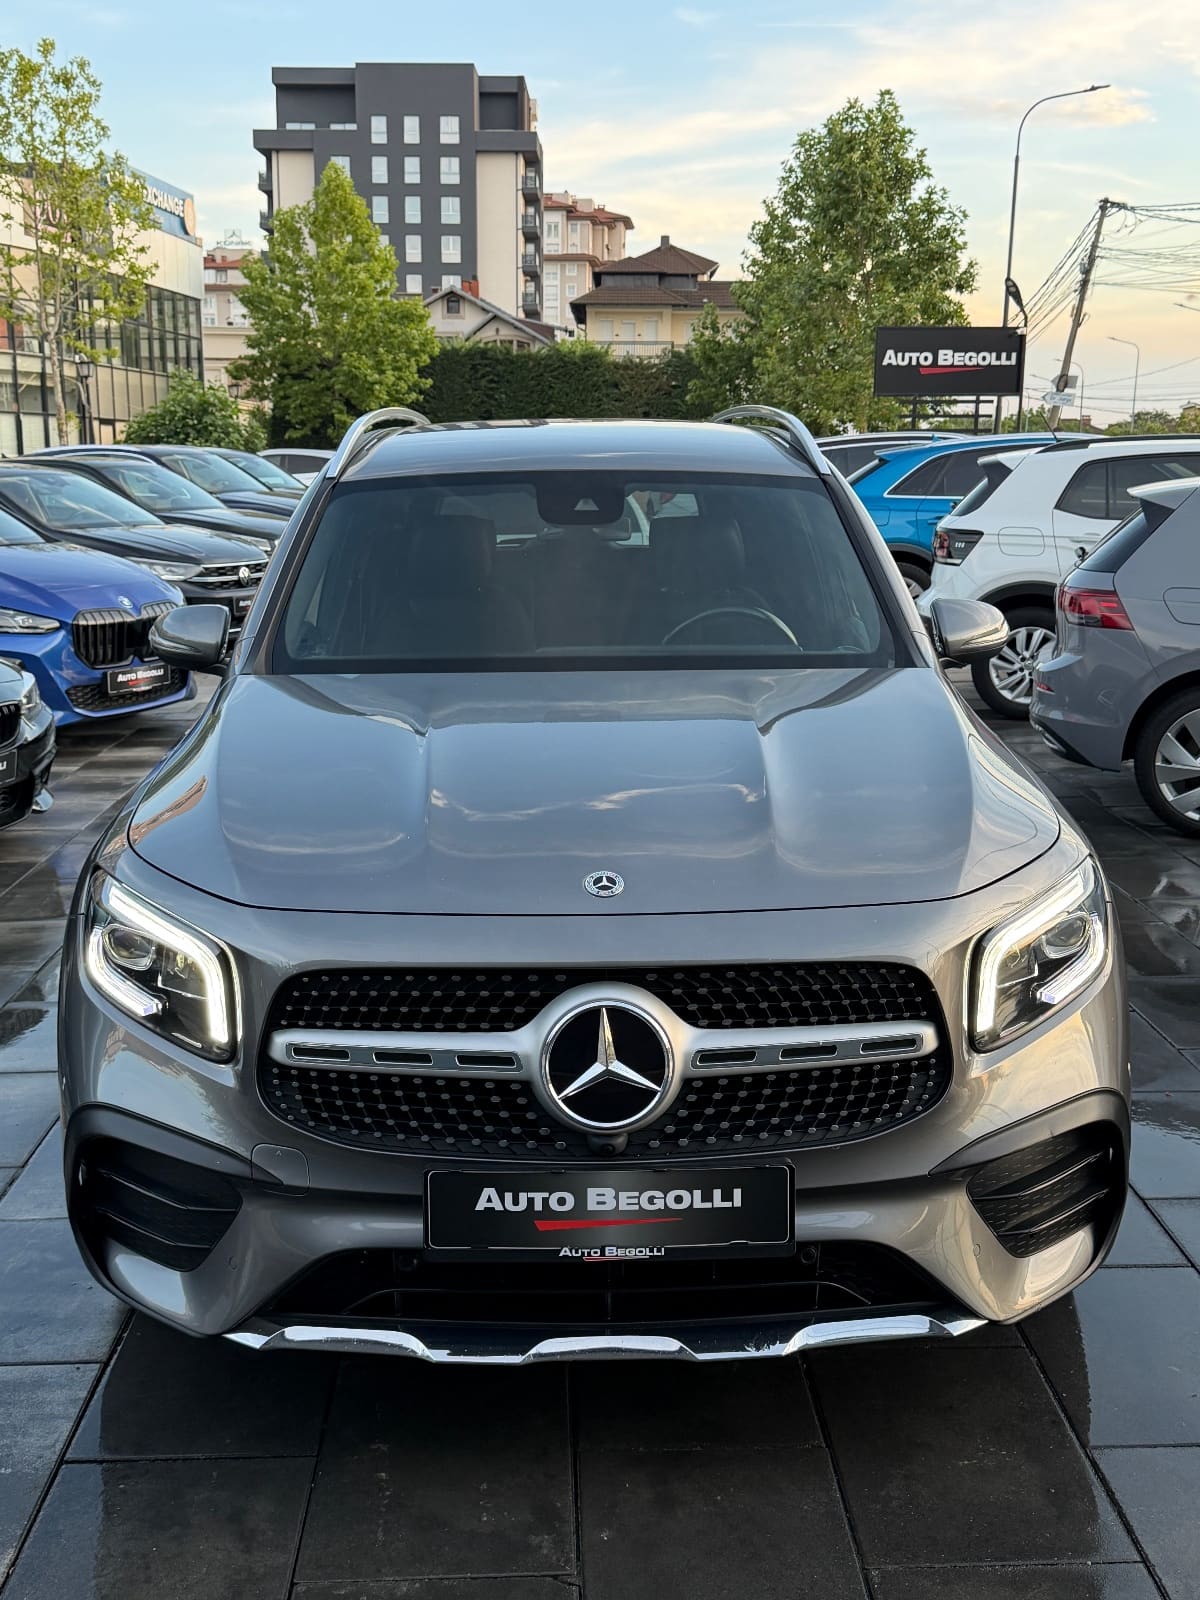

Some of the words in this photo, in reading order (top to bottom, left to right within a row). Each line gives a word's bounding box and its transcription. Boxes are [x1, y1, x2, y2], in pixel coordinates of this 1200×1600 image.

[882, 349, 934, 366] AUTO
[937, 349, 1017, 366] BEGOLLI
[474, 1187, 575, 1212] AUTO
[586, 1187, 742, 1211] BEGOLLI
[558, 1246, 601, 1257] AUTO
[604, 1246, 665, 1257] BEGOLLI
